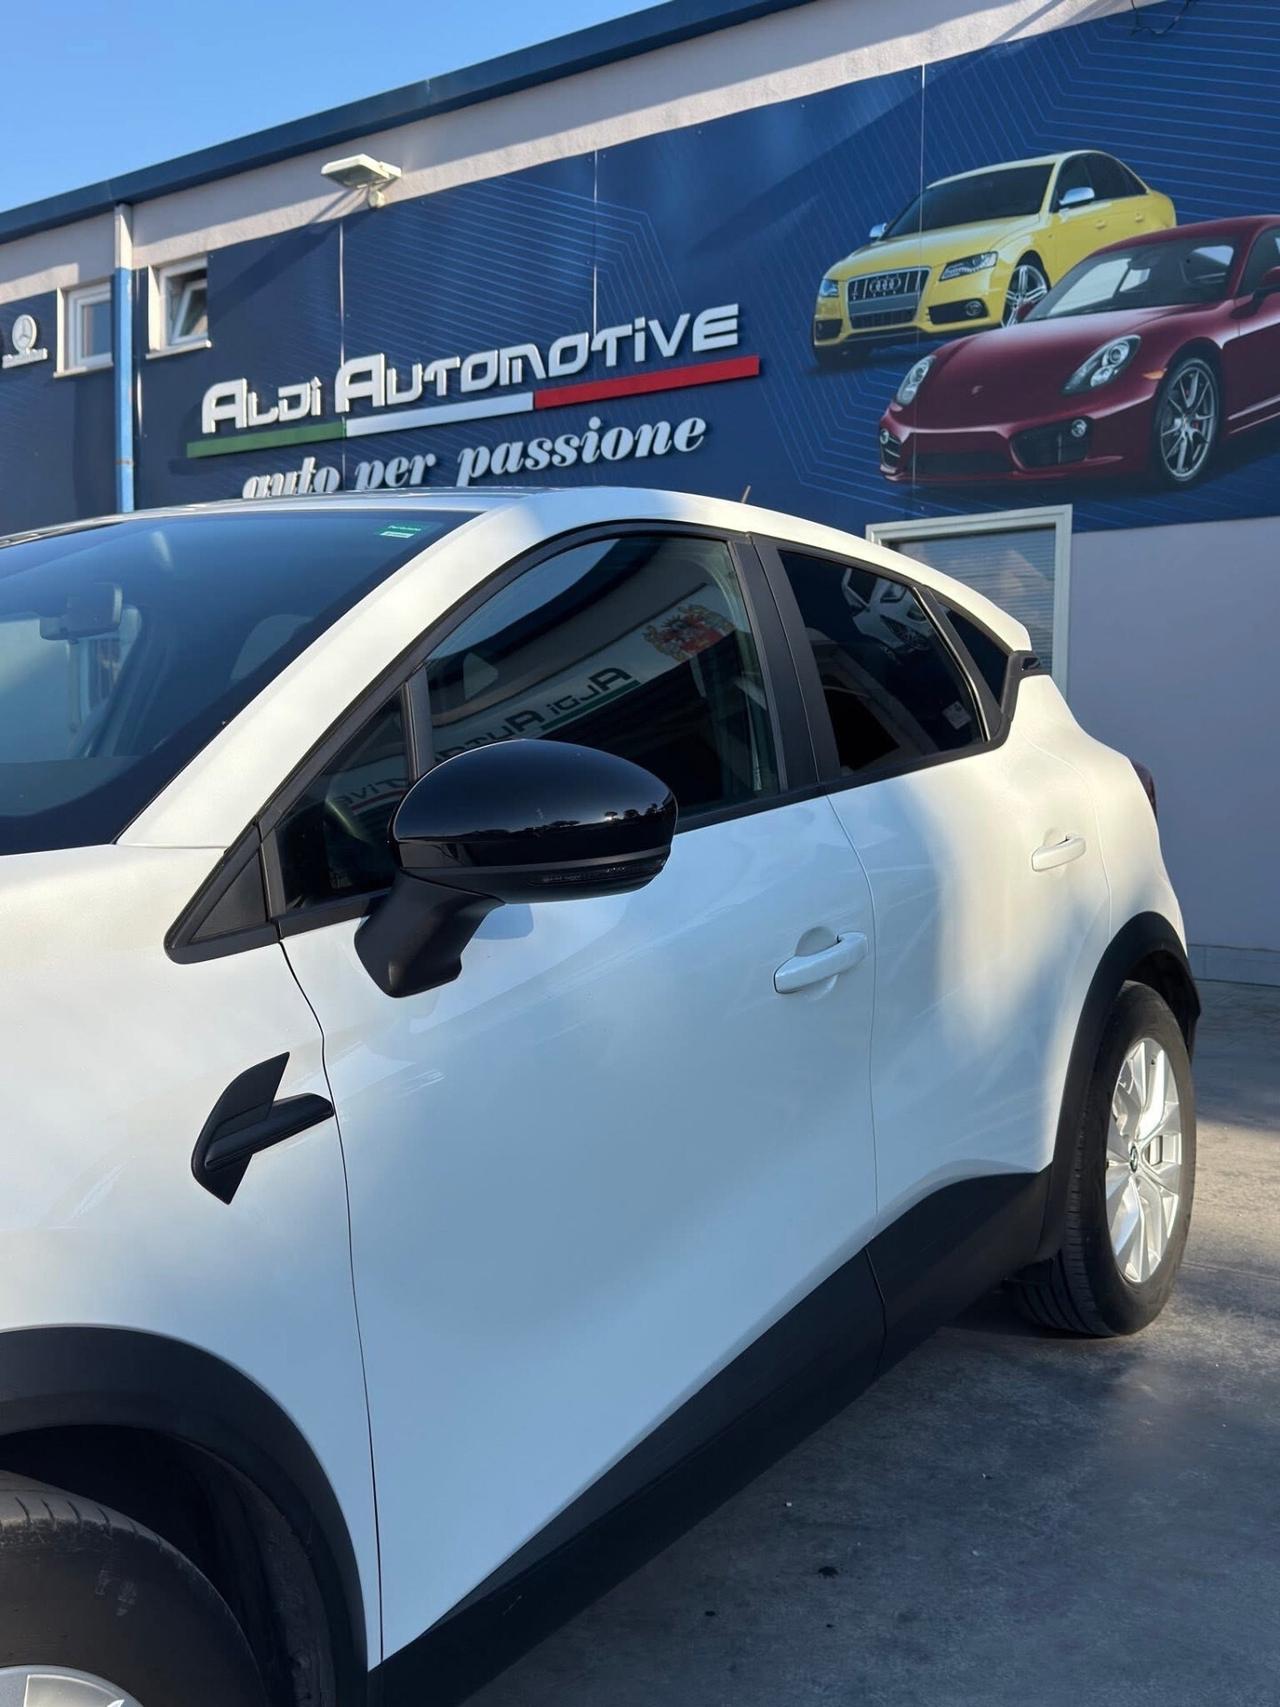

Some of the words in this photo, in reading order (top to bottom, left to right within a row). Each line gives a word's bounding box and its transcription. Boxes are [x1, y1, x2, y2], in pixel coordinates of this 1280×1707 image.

[242, 456, 341, 498] auto
[355, 453, 437, 490] per
[456, 417, 706, 487] passione
